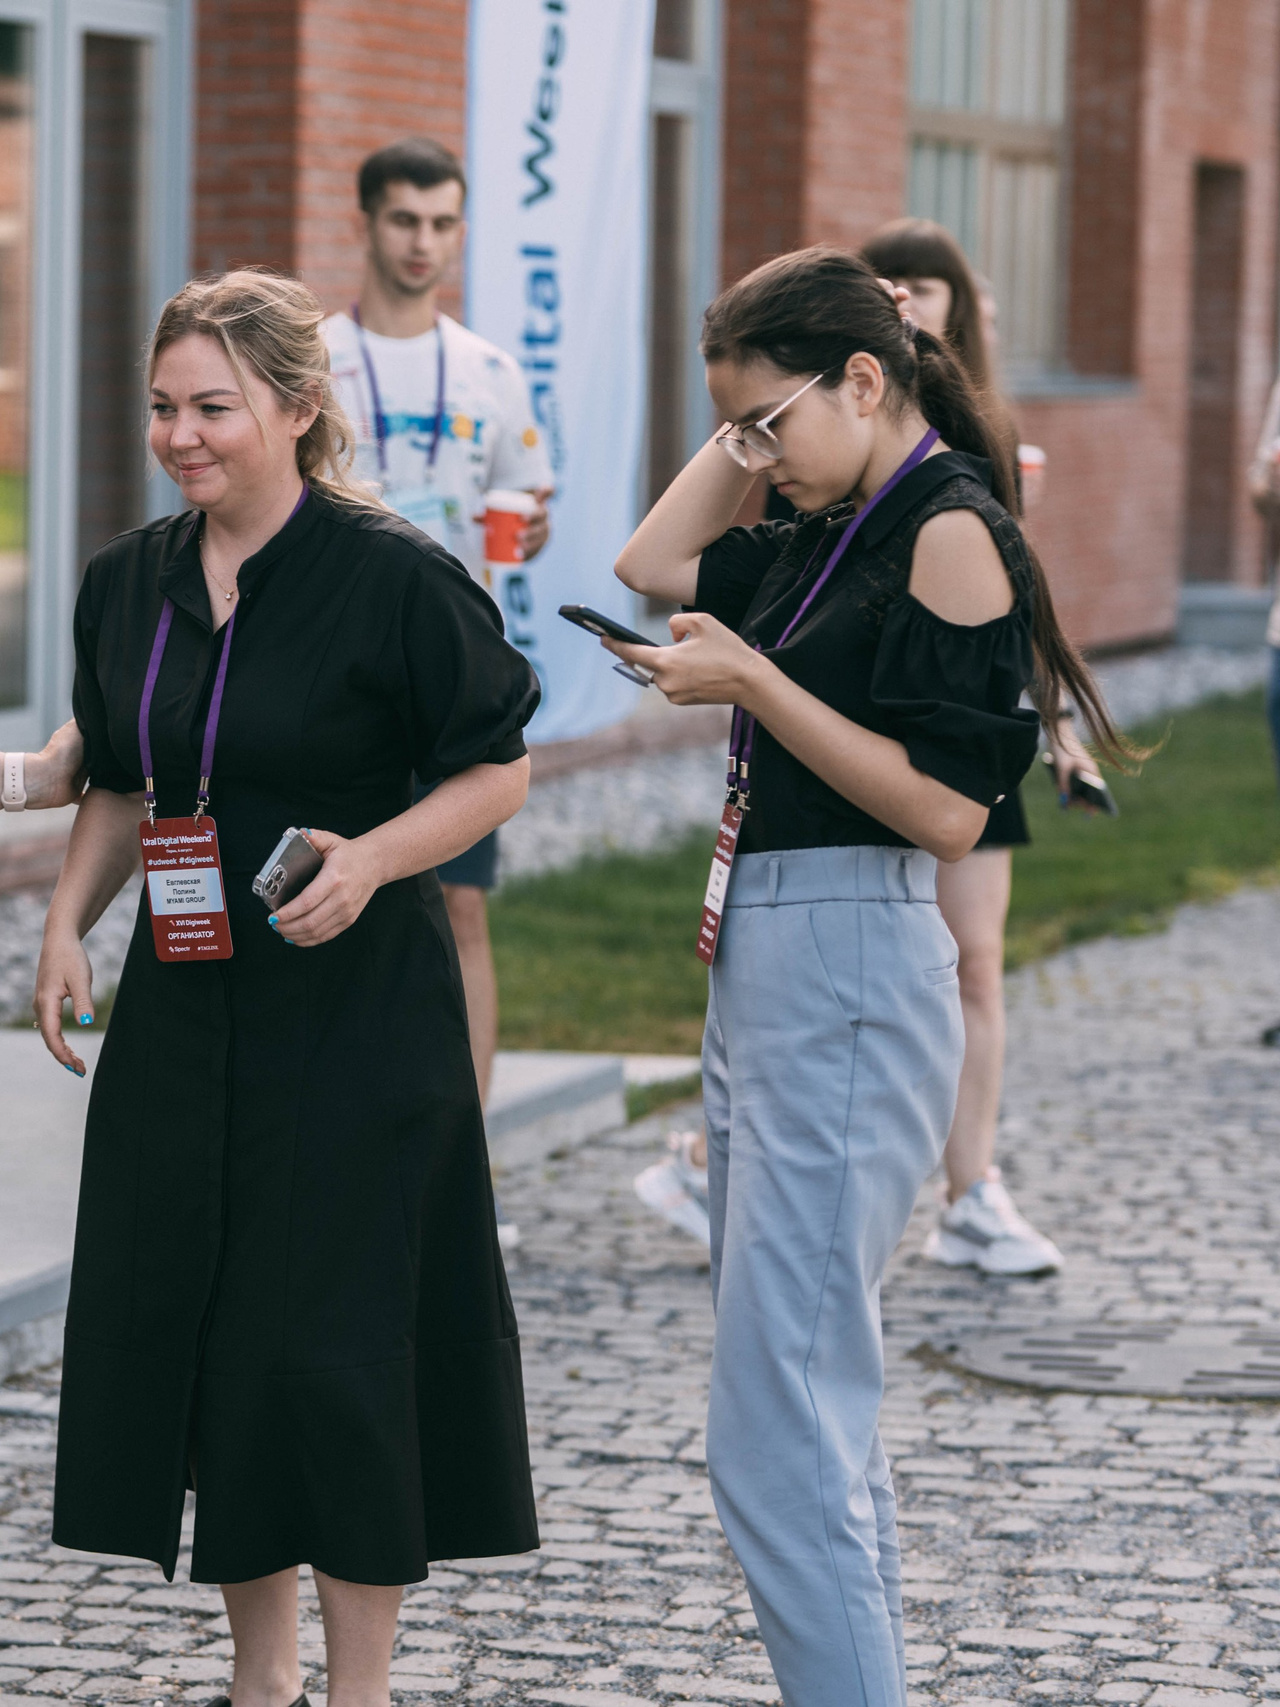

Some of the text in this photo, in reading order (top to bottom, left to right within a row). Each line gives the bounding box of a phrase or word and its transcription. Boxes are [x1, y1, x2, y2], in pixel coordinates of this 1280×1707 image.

[521, 0, 567, 208] Wee
[520, 245, 562, 426] ital
[142, 834, 212, 847] Ural Digital Weekend
[147, 854, 215, 866] #udweek #digiweek
[185, 896, 206, 904] GROUP
[185, 918, 211, 927] Digiweek
[167, 930, 215, 940] ОРГАНИЗАТОР
